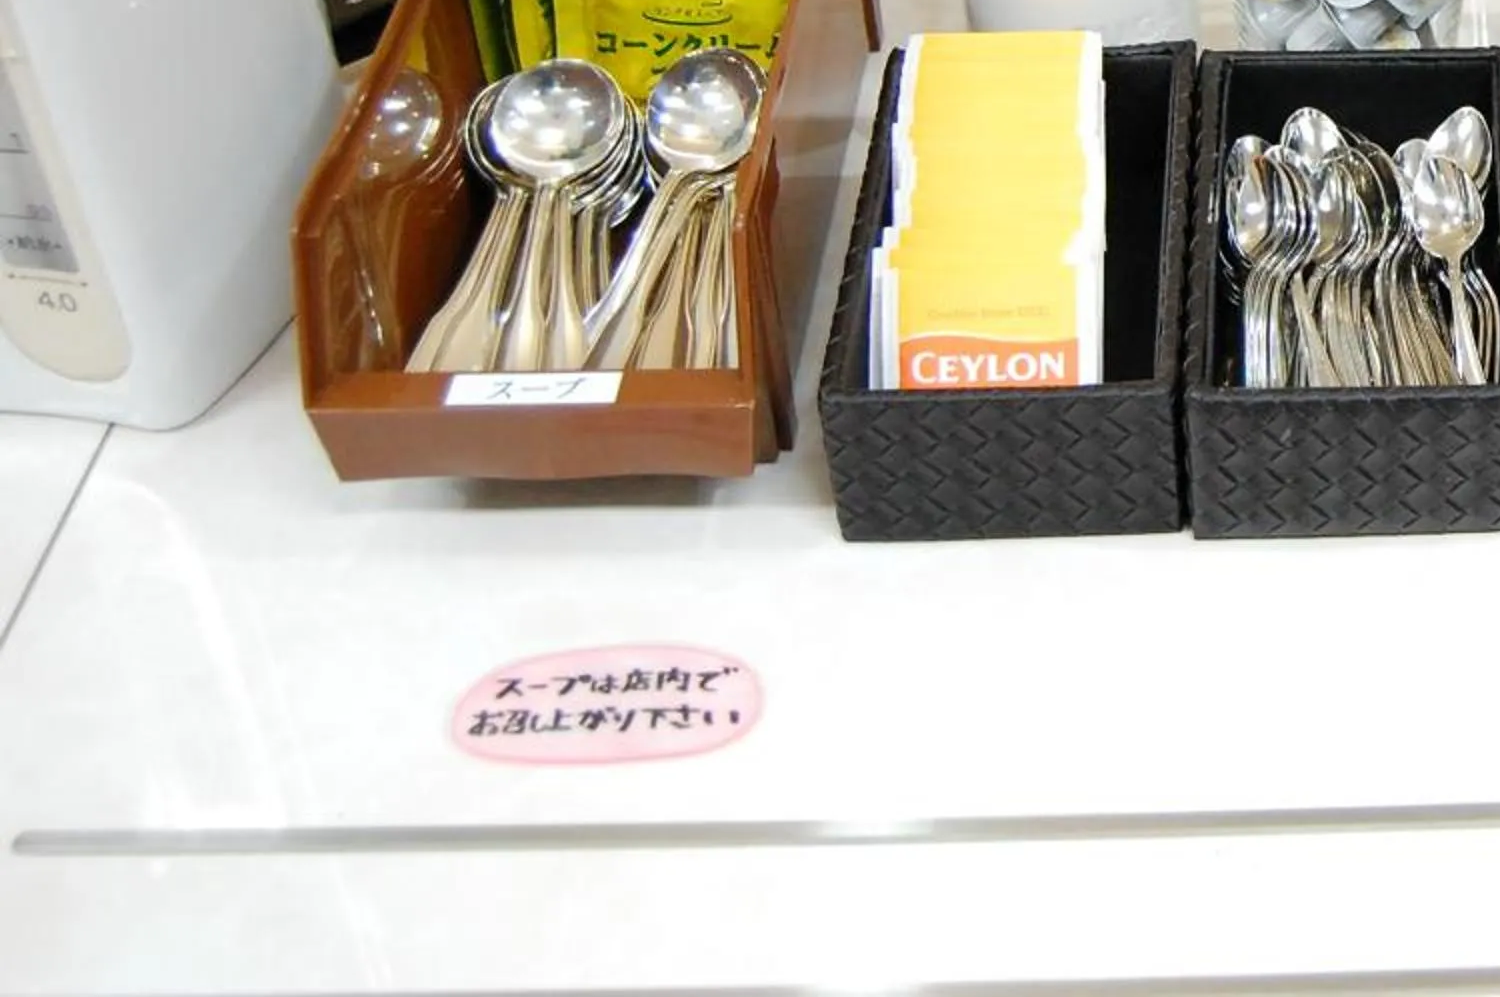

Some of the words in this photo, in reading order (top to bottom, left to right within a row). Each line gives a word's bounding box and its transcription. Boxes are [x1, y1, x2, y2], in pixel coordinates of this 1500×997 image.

[911, 350, 1066, 385] CEYLON
[494, 666, 740, 700] スープは店内で
